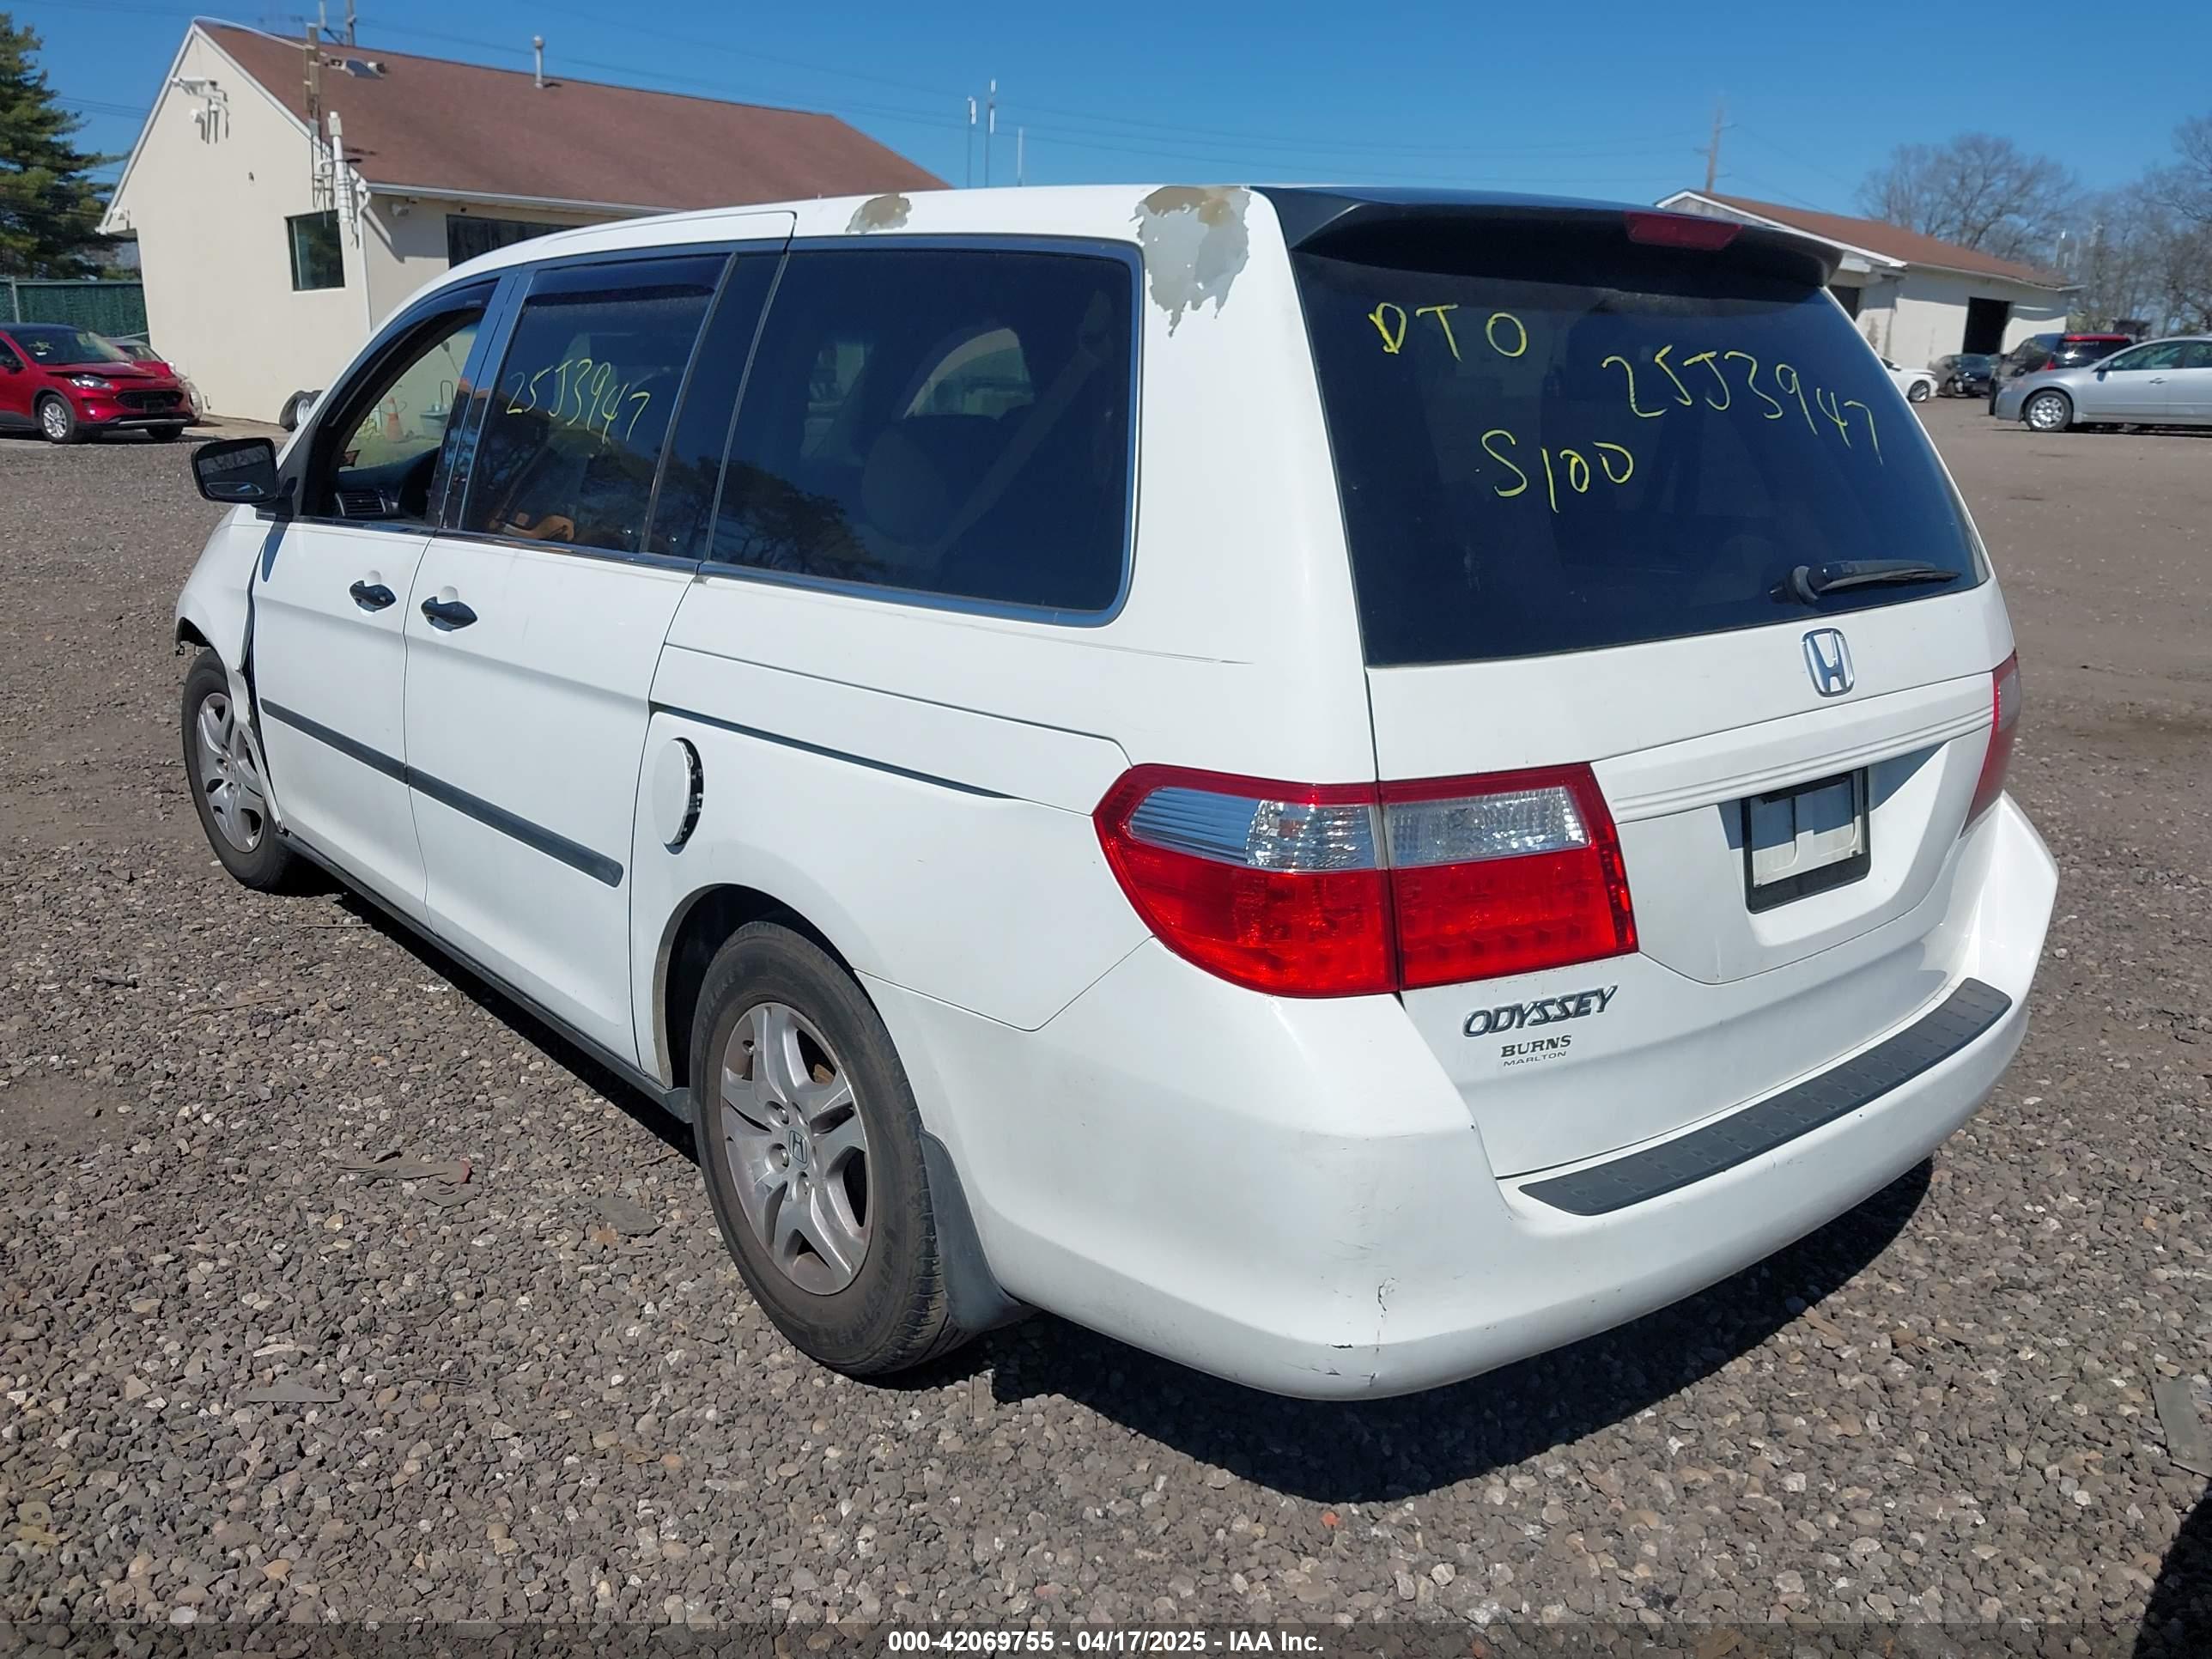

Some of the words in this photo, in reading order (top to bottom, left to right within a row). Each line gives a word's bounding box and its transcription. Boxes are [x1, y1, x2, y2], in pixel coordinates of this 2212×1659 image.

[506, 357, 651, 445] 25J3947
[1601, 344, 1884, 466] 25J3947
[1462, 985, 1619, 1037] ODYSSEY
[1500, 1034, 1572, 1058] BURNS
[1503, 1050, 1567, 1067] MARLTON
